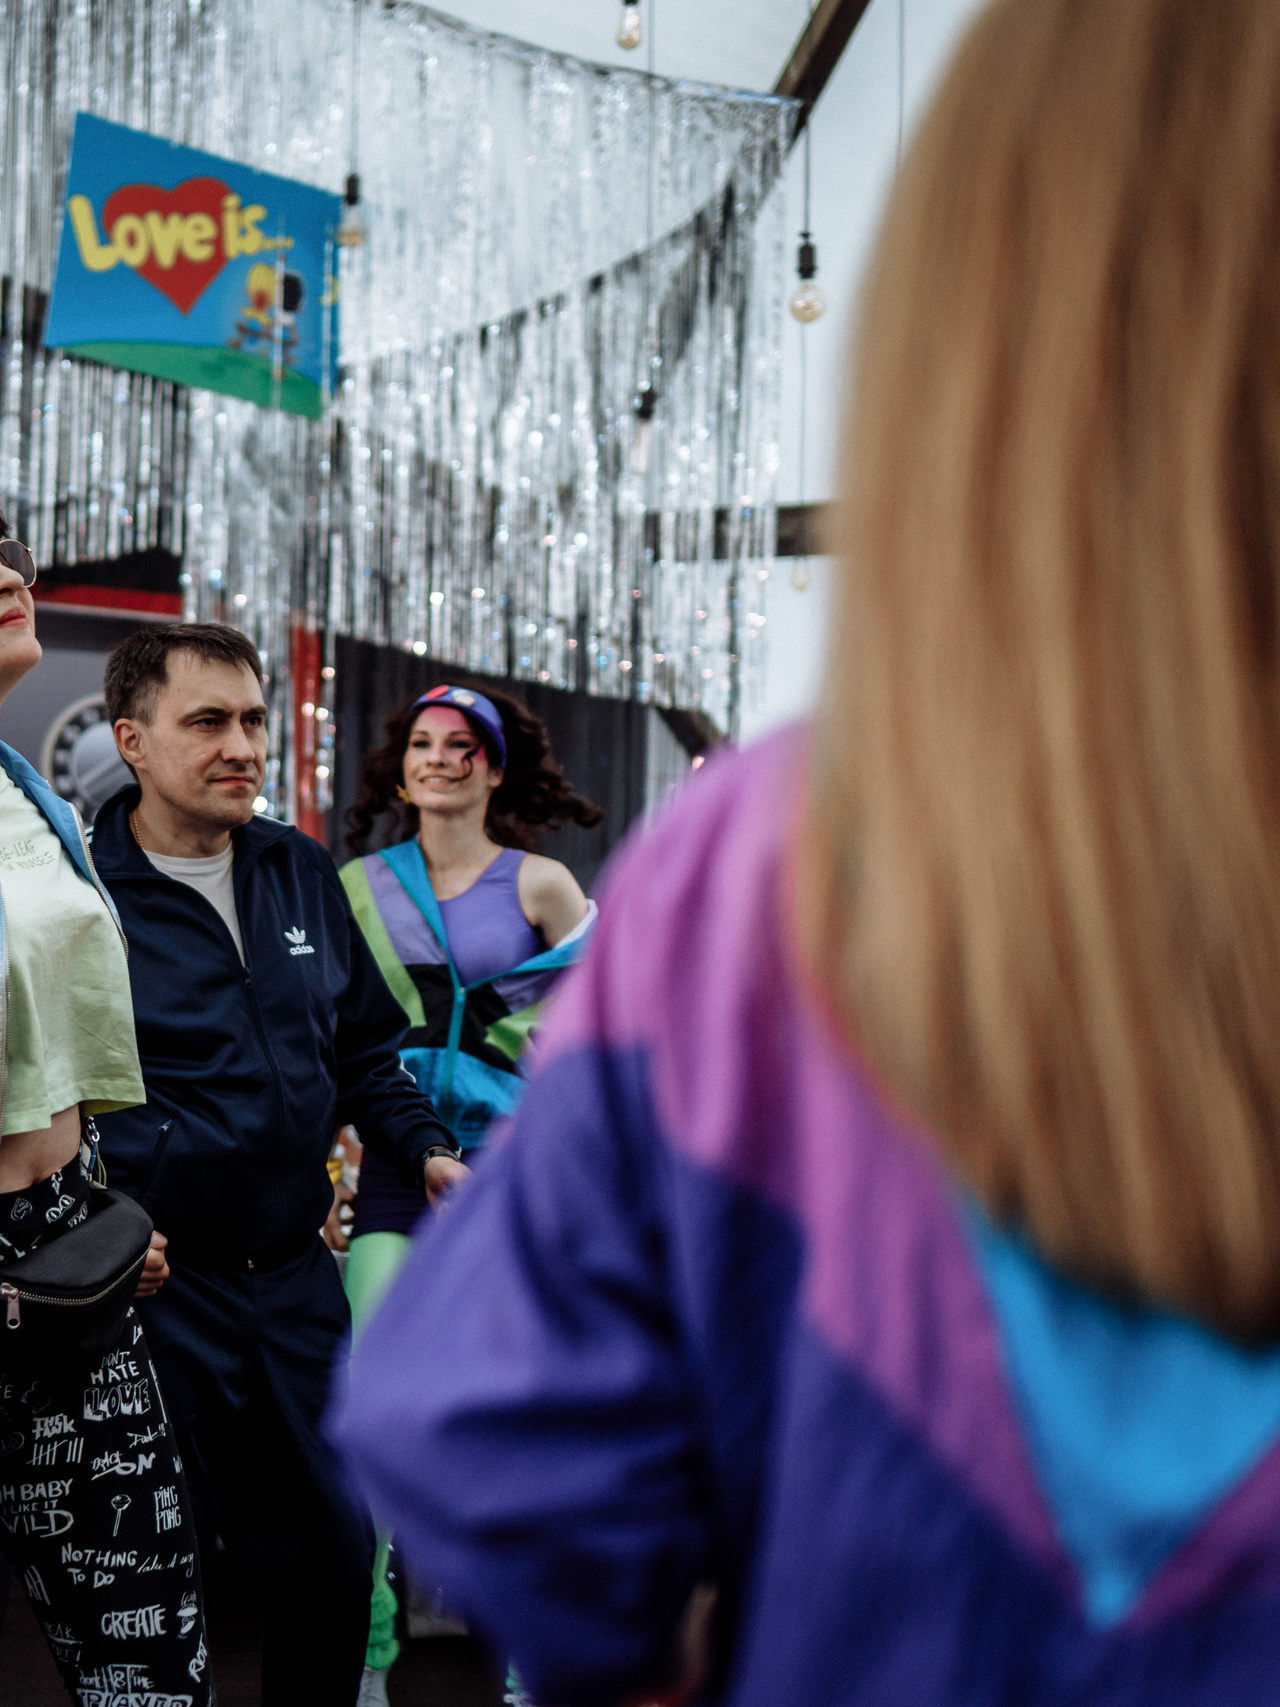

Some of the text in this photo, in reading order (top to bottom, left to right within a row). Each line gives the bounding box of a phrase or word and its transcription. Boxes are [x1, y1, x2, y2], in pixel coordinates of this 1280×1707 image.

[70, 194, 218, 272] Love
[290, 944, 315, 956] adidas
[90, 1361, 140, 1386] HATE
[83, 1378, 151, 1422] LOVE
[20, 1478, 73, 1501] BABY
[10, 1502, 40, 1514] LIKE
[44, 1499, 58, 1511] IT
[155, 1505, 182, 1534] PONG
[0, 1509, 75, 1538] WILD
[101, 1604, 167, 1640] CREATE
